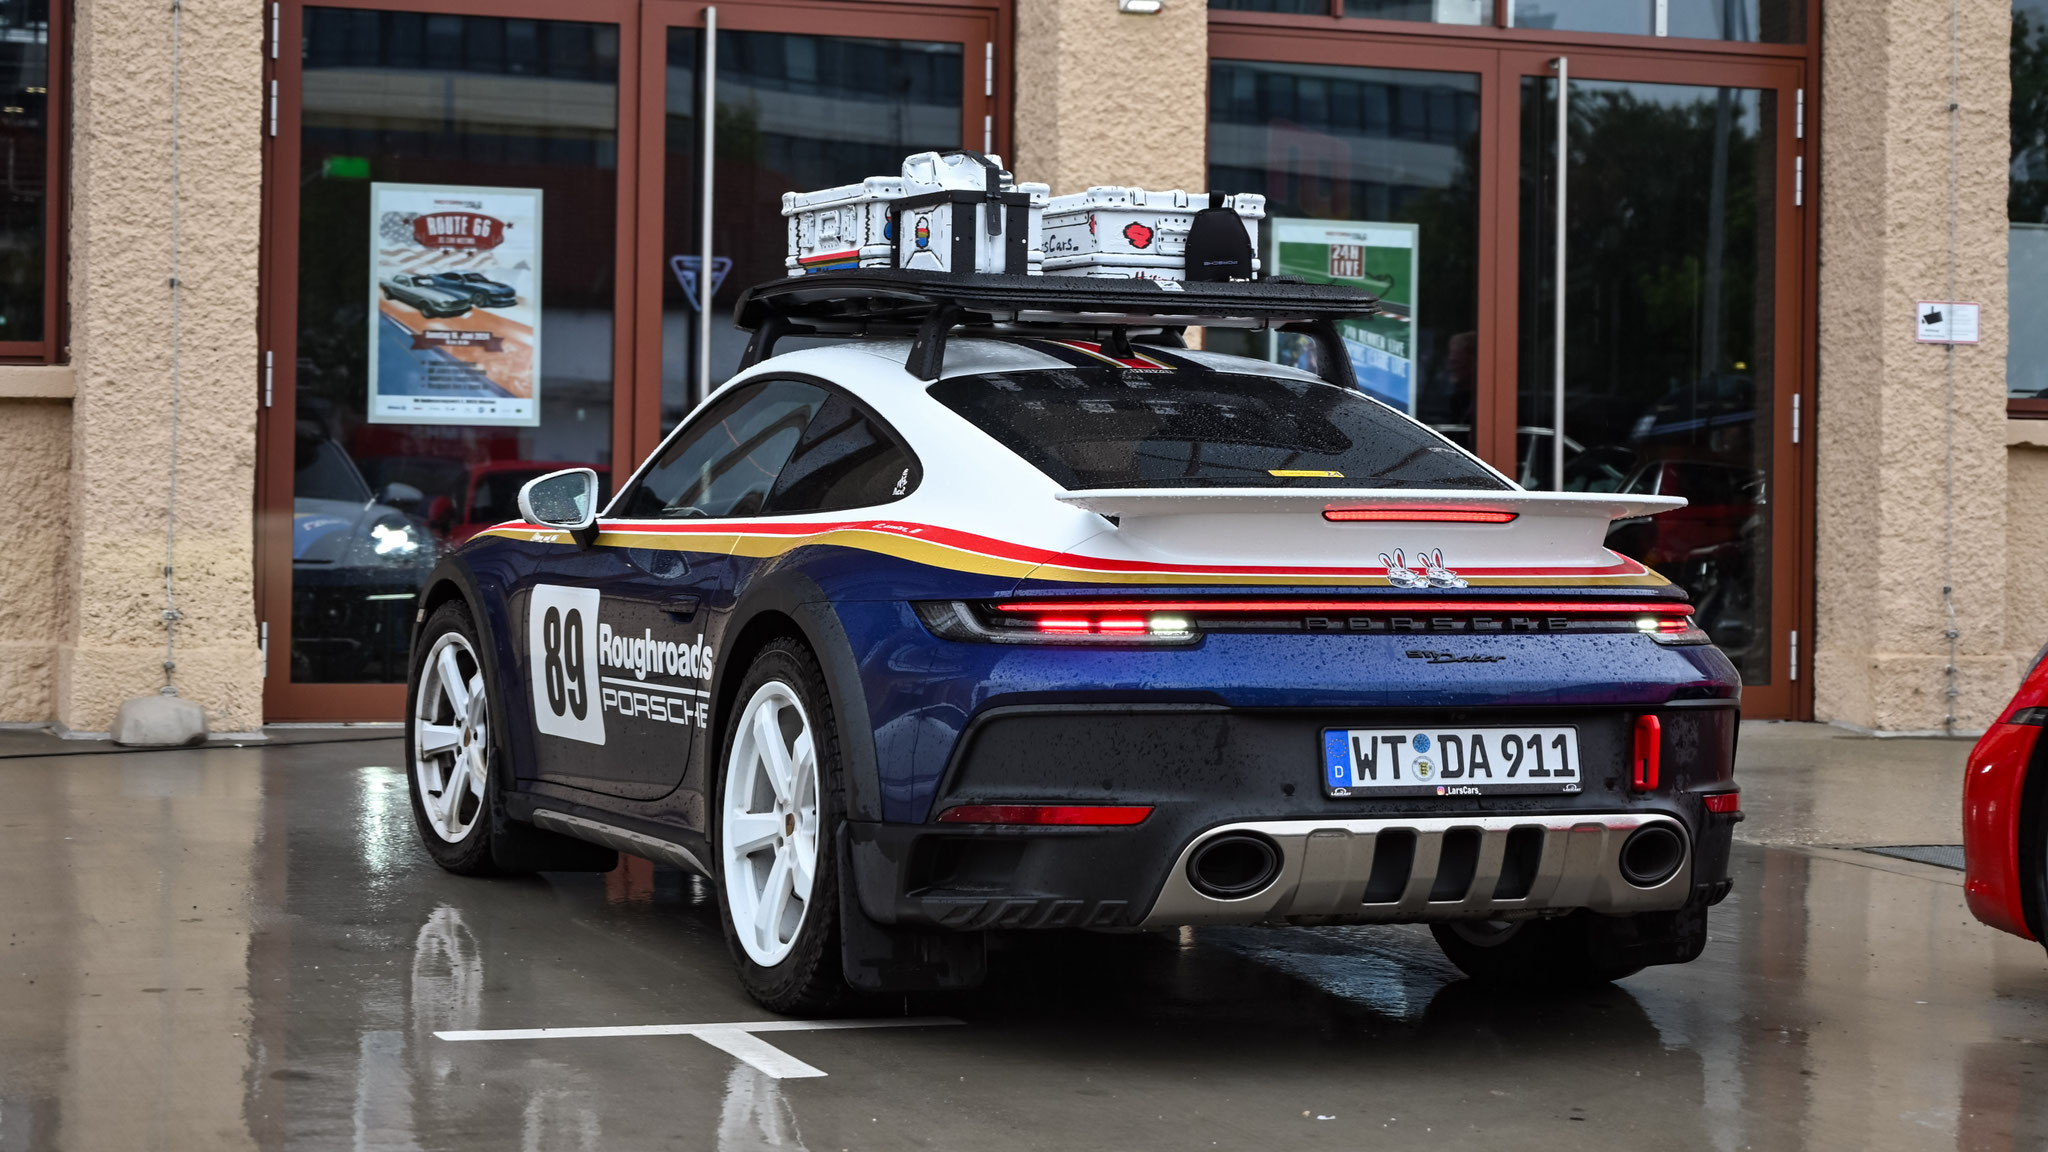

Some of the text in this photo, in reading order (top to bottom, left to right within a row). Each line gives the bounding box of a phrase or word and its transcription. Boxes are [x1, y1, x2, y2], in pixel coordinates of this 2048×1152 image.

[426, 215, 492, 238] ROUTE 66
[1332, 246, 1359, 260] 24H
[1333, 260, 1360, 276] LIVE
[1304, 616, 1569, 631] PORSCHE
[599, 623, 713, 681] Roughroads
[1427, 653, 1507, 664] Dakar
[543, 606, 588, 721] 89
[602, 687, 710, 729] PORSCHE
[1351, 734, 1576, 780] WT DA 911
[1334, 765, 1344, 778] D
